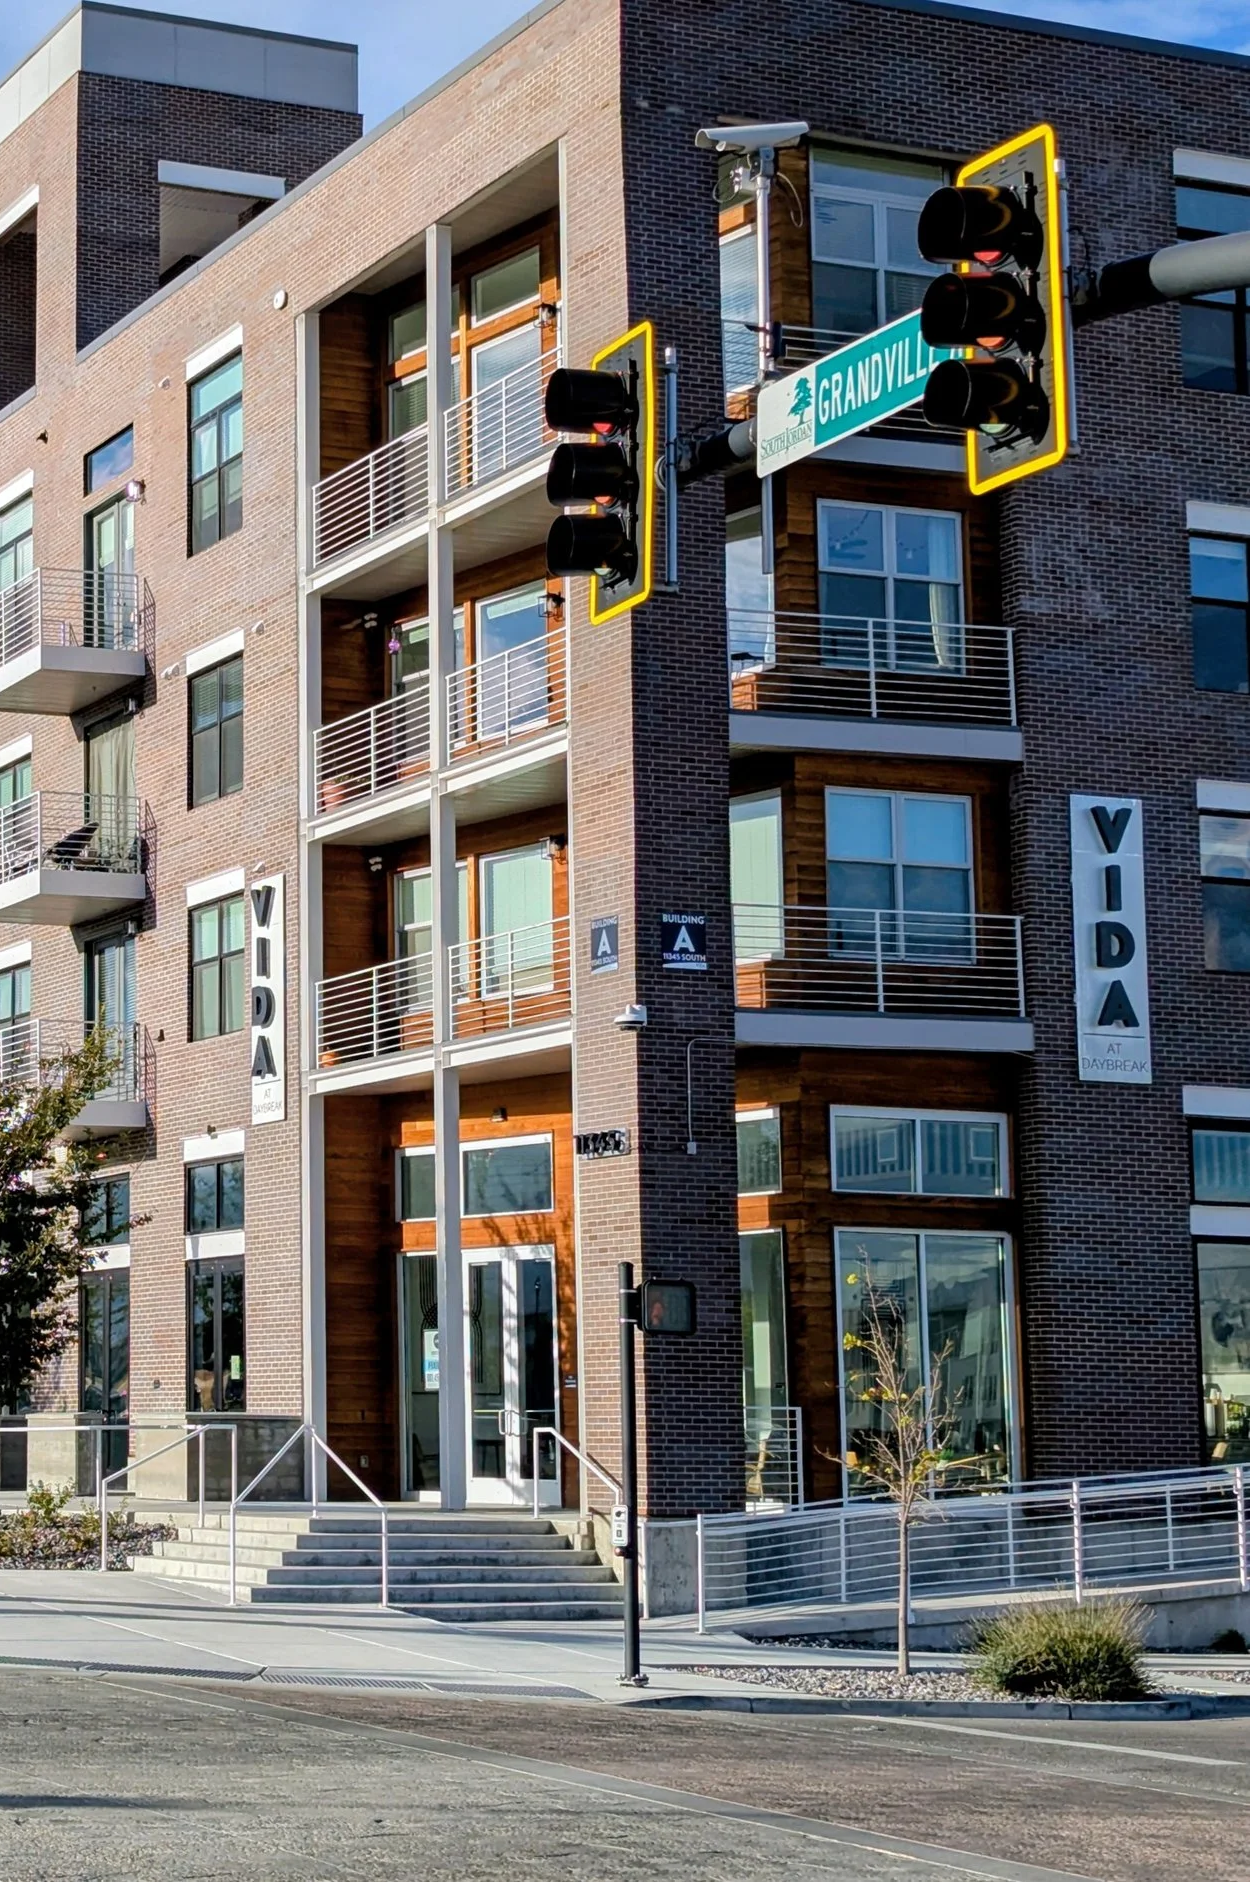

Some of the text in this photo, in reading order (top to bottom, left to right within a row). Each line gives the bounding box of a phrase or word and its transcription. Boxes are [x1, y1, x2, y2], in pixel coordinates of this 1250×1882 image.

[591, 916, 618, 930] BUILDING
[662, 913, 705, 925] BUILDING
[1090, 805, 1140, 1029] VIDA
[597, 929, 612, 957] A
[673, 925, 696, 953] A
[662, 952, 706, 962] 11345 SOUTH
[251, 885, 276, 1078] VIDA
[1106, 1042, 1123, 1055] AT
[1081, 1057, 1150, 1073] DAYBREAK
